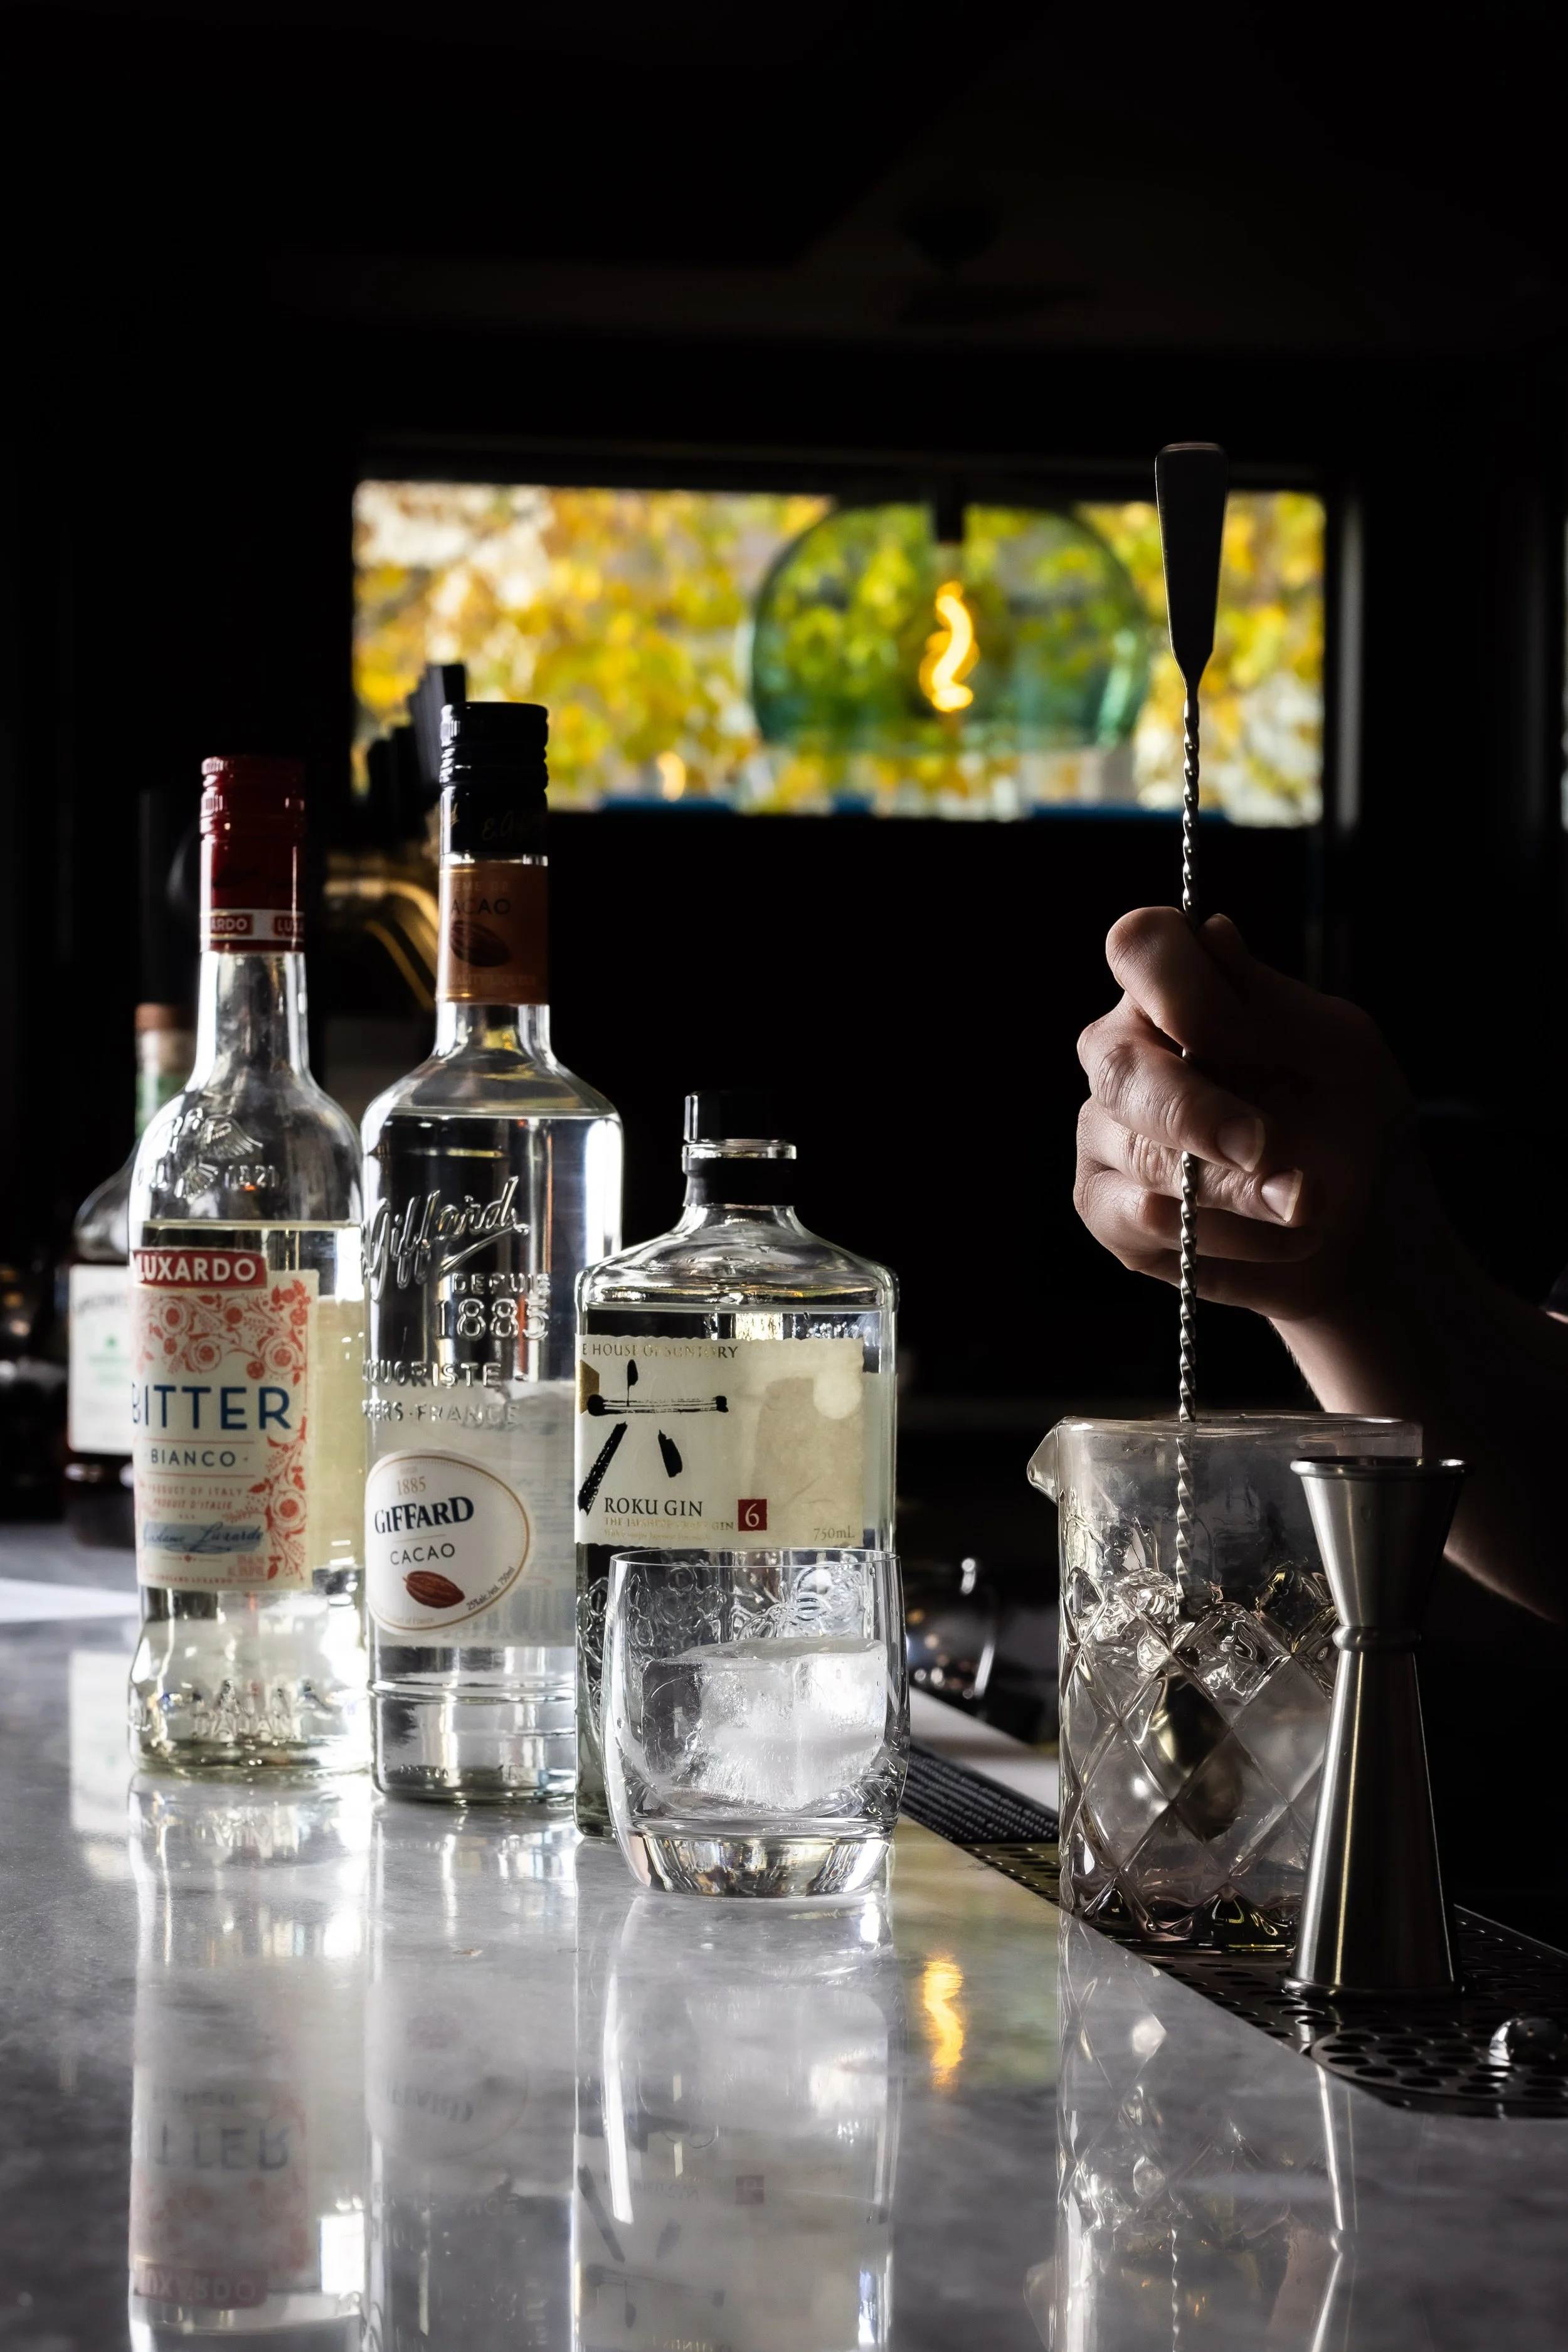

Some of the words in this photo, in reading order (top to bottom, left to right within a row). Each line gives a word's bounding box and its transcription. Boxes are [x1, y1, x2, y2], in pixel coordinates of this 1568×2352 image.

[452, 898, 511, 915] ACAO
[211, 917, 247, 932] ARDO
[136, 1254, 256, 1282] LUXARDO
[451, 1272, 552, 1296] DEPUIS
[437, 1297, 551, 1343] 1885
[592, 1343, 637, 1358] HOUSE
[643, 1344, 659, 1358] OF
[664, 1345, 738, 1360] SUNTORY
[362, 1359, 502, 1390] IQUORISTE
[132, 1381, 292, 1430] BITTER
[416, 1403, 520, 1424] FRANCE
[151, 1447, 236, 1468] BIANCO
[208, 1487, 242, 1497] ITALY
[396, 1476, 426, 1496] 1885
[374, 1496, 475, 1535] GIFFARD
[604, 1497, 659, 1515] ROKU
[664, 1499, 703, 1517] GIN
[744, 1503, 760, 1528] 6
[711, 1521, 734, 1531] GIN
[813, 1525, 856, 1541] 750mL
[390, 1542, 456, 1565] CACAO
